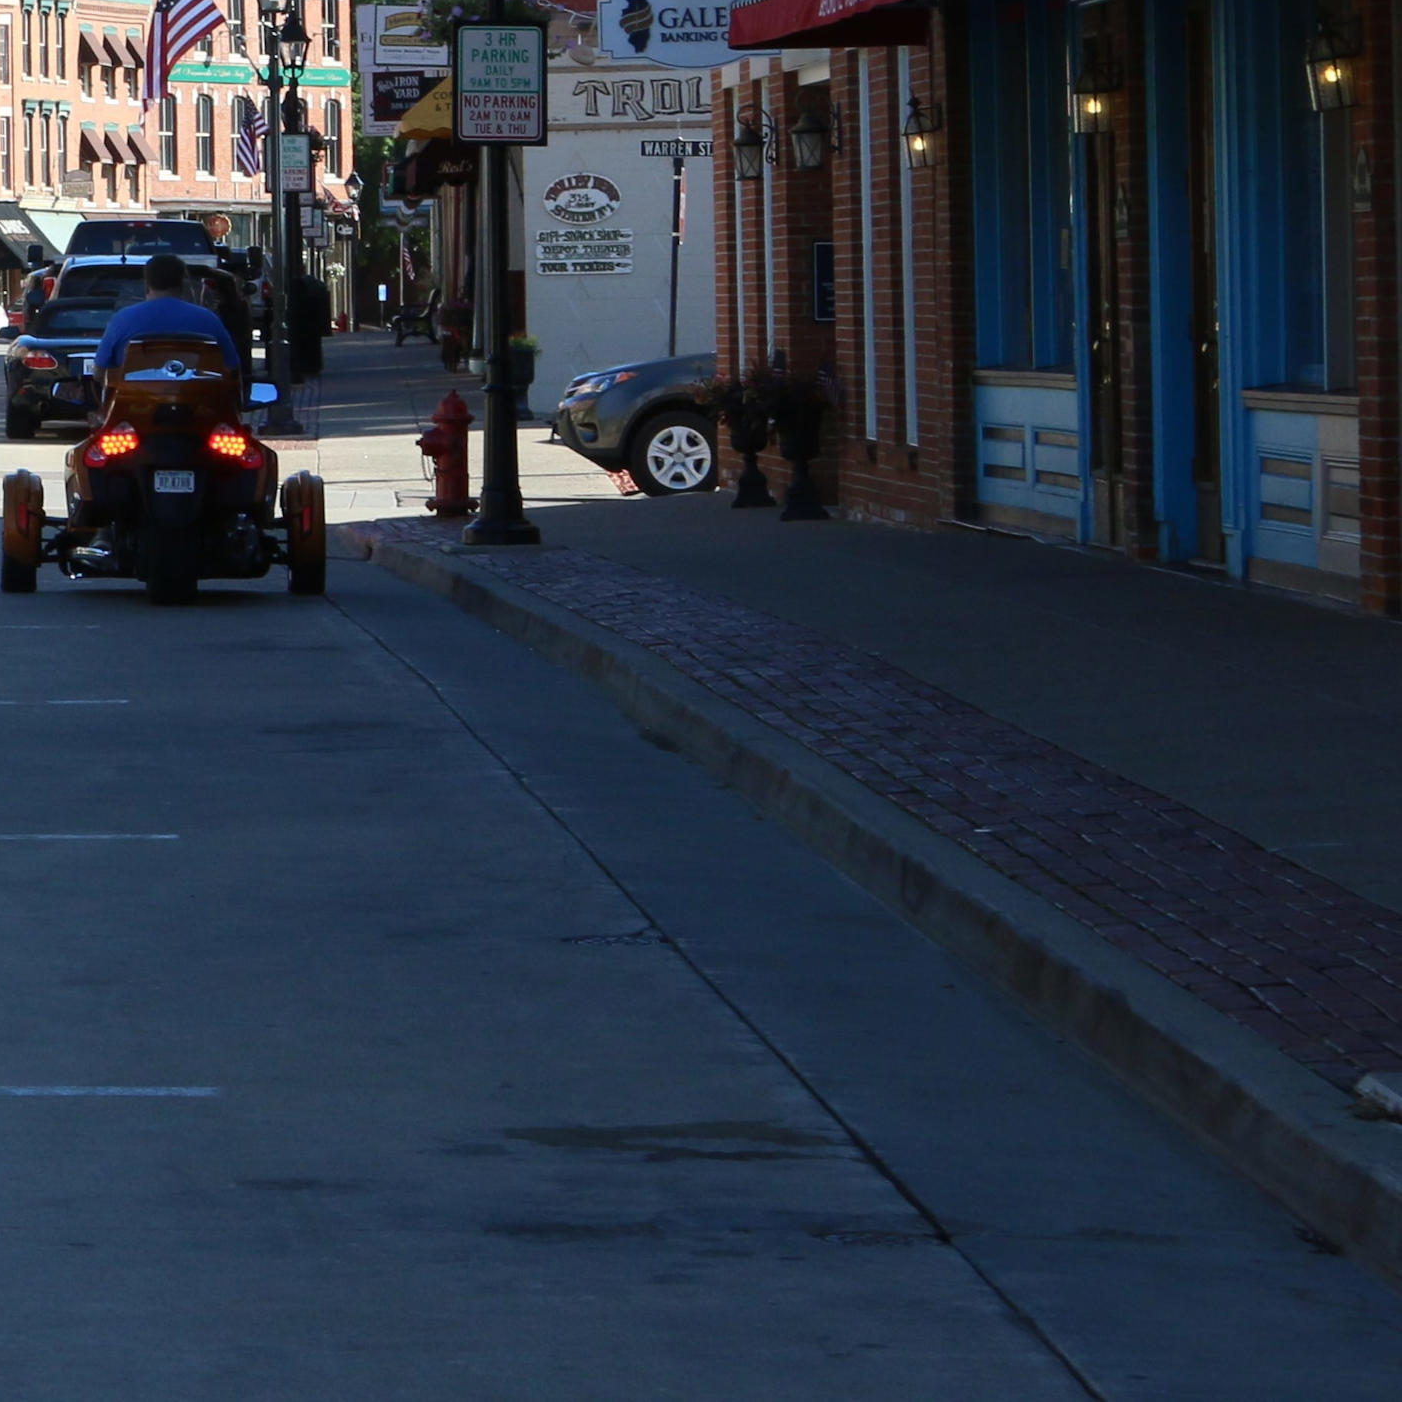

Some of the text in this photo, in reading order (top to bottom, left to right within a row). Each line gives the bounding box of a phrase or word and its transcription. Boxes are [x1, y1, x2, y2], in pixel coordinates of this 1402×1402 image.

[658, 6, 728, 29] GALE
[485, 32, 517, 46] 3 HR
[661, 31, 717, 43] BANKING
[471, 49, 529, 63] PARKING
[485, 65, 514, 76] DAILY
[394, 76, 419, 86] IRON
[470, 78, 531, 88] 9AM TO 5PM
[394, 88, 419, 98] YARD
[572, 76, 712, 121] TROL
[464, 95, 536, 109] NO PARKING
[469, 111, 531, 121] 2AM TO 6AM
[474, 123, 526, 135] TUE & THU
[644, 142, 693, 156] WARREN
[542, 245, 579, 254] DEPOT
[540, 262, 568, 272] TOUR
